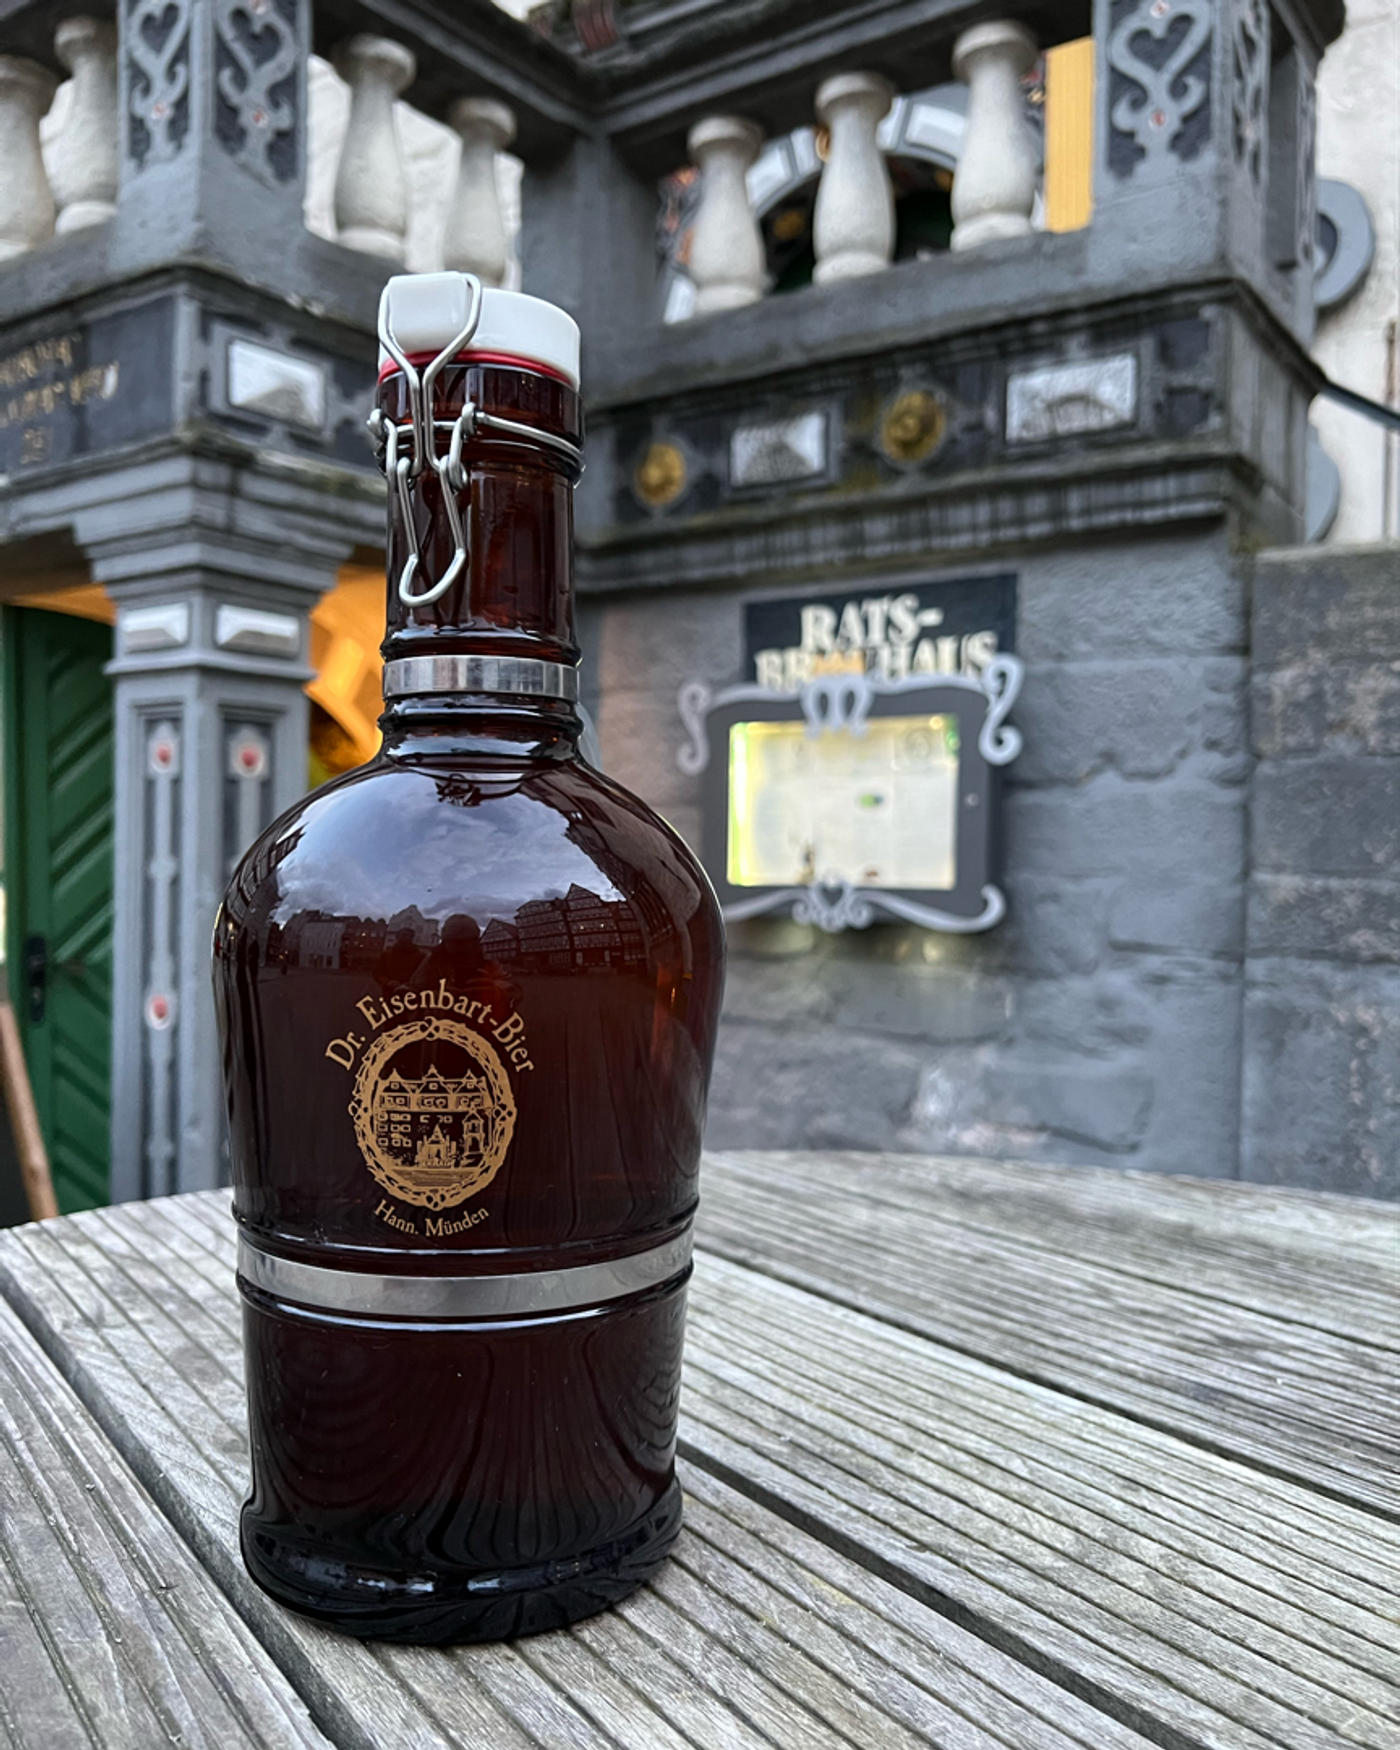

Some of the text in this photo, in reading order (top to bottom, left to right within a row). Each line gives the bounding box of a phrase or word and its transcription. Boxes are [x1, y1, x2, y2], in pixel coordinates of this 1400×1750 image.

[800, 593, 943, 652] RATS-
[754, 630, 998, 692] BRHAUS
[325, 978, 535, 1073] Dr. Eisenbart-Bier
[373, 1199, 489, 1238] Hann. Münden
